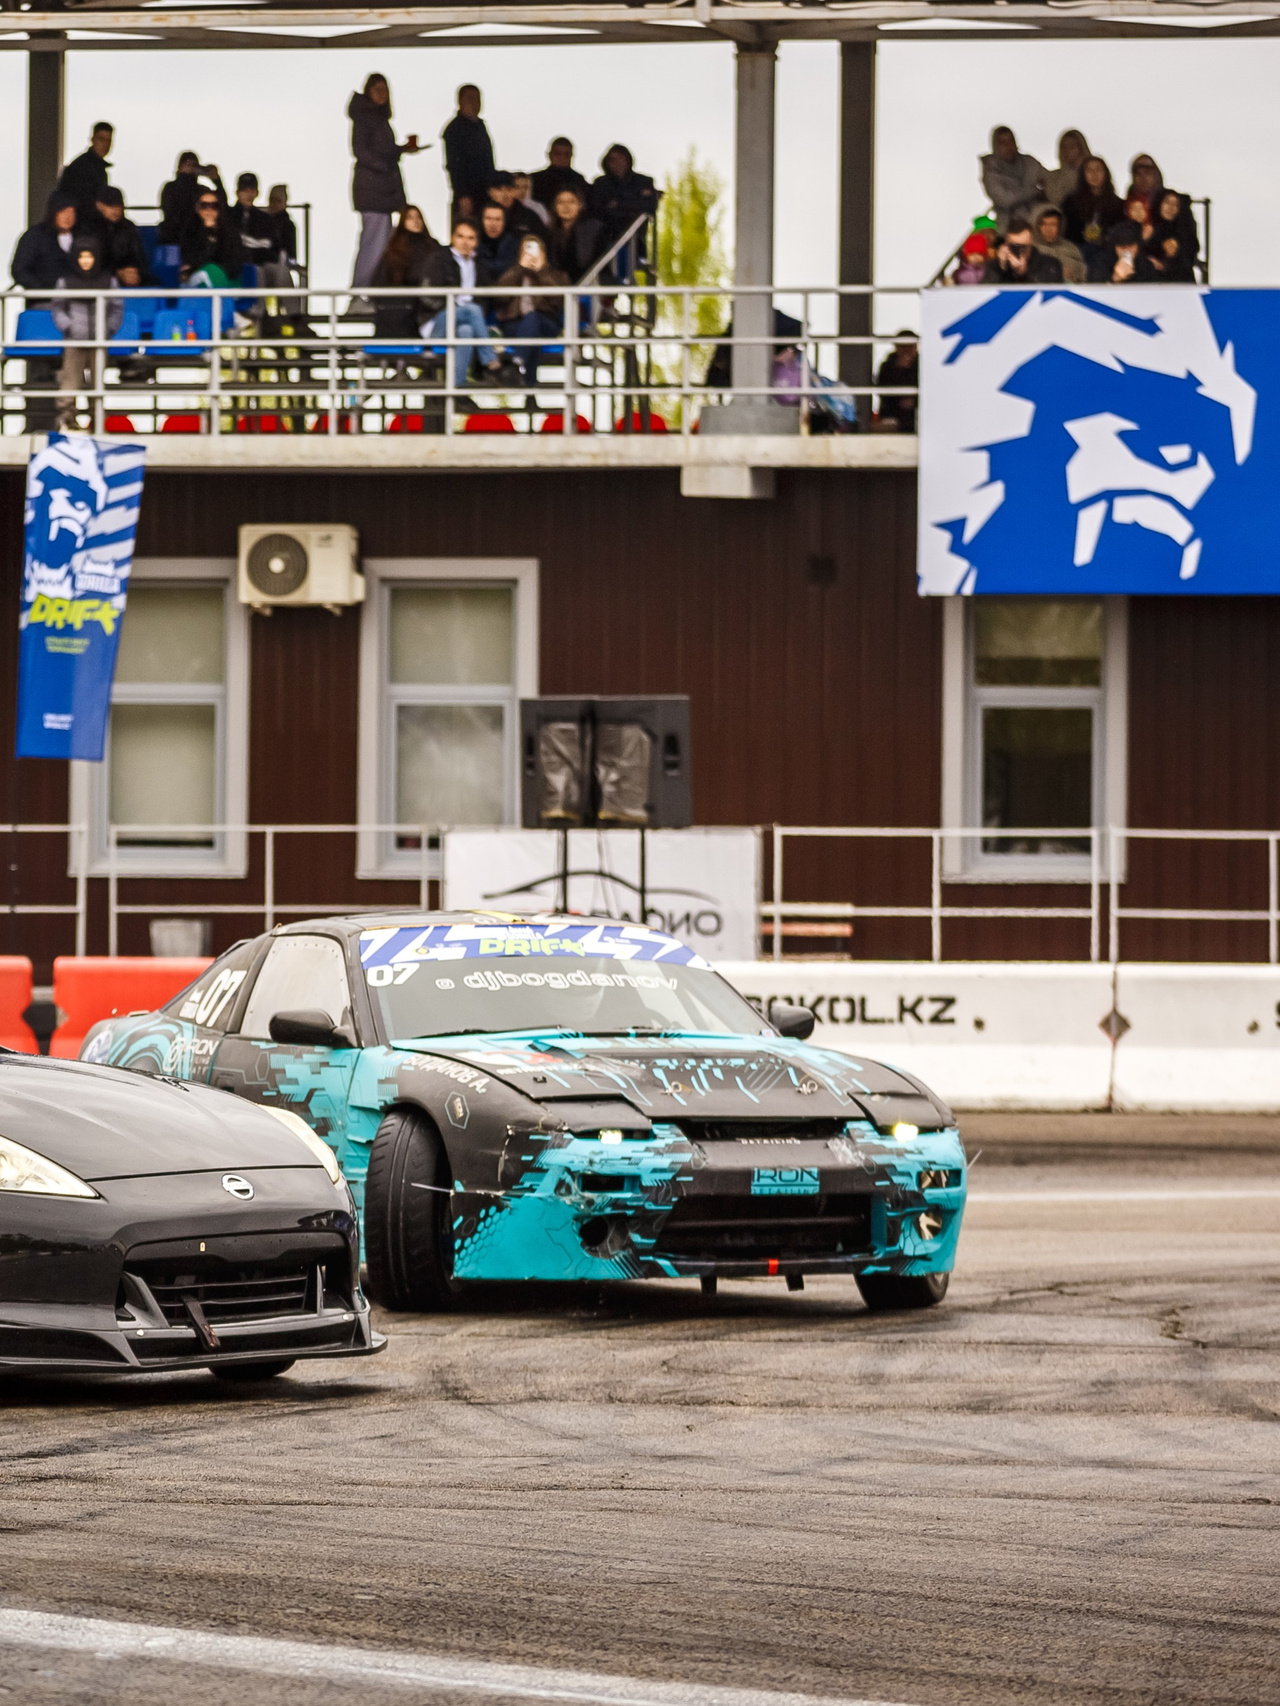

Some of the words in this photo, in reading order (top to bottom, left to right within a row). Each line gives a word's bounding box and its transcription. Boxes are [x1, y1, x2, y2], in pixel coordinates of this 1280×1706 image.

[29, 593, 120, 636] DRIFT
[478, 938, 586, 957] DRIFT
[366, 963, 420, 987] 07
[463, 969, 678, 991] djbogdanov
[195, 968, 247, 1028] 07
